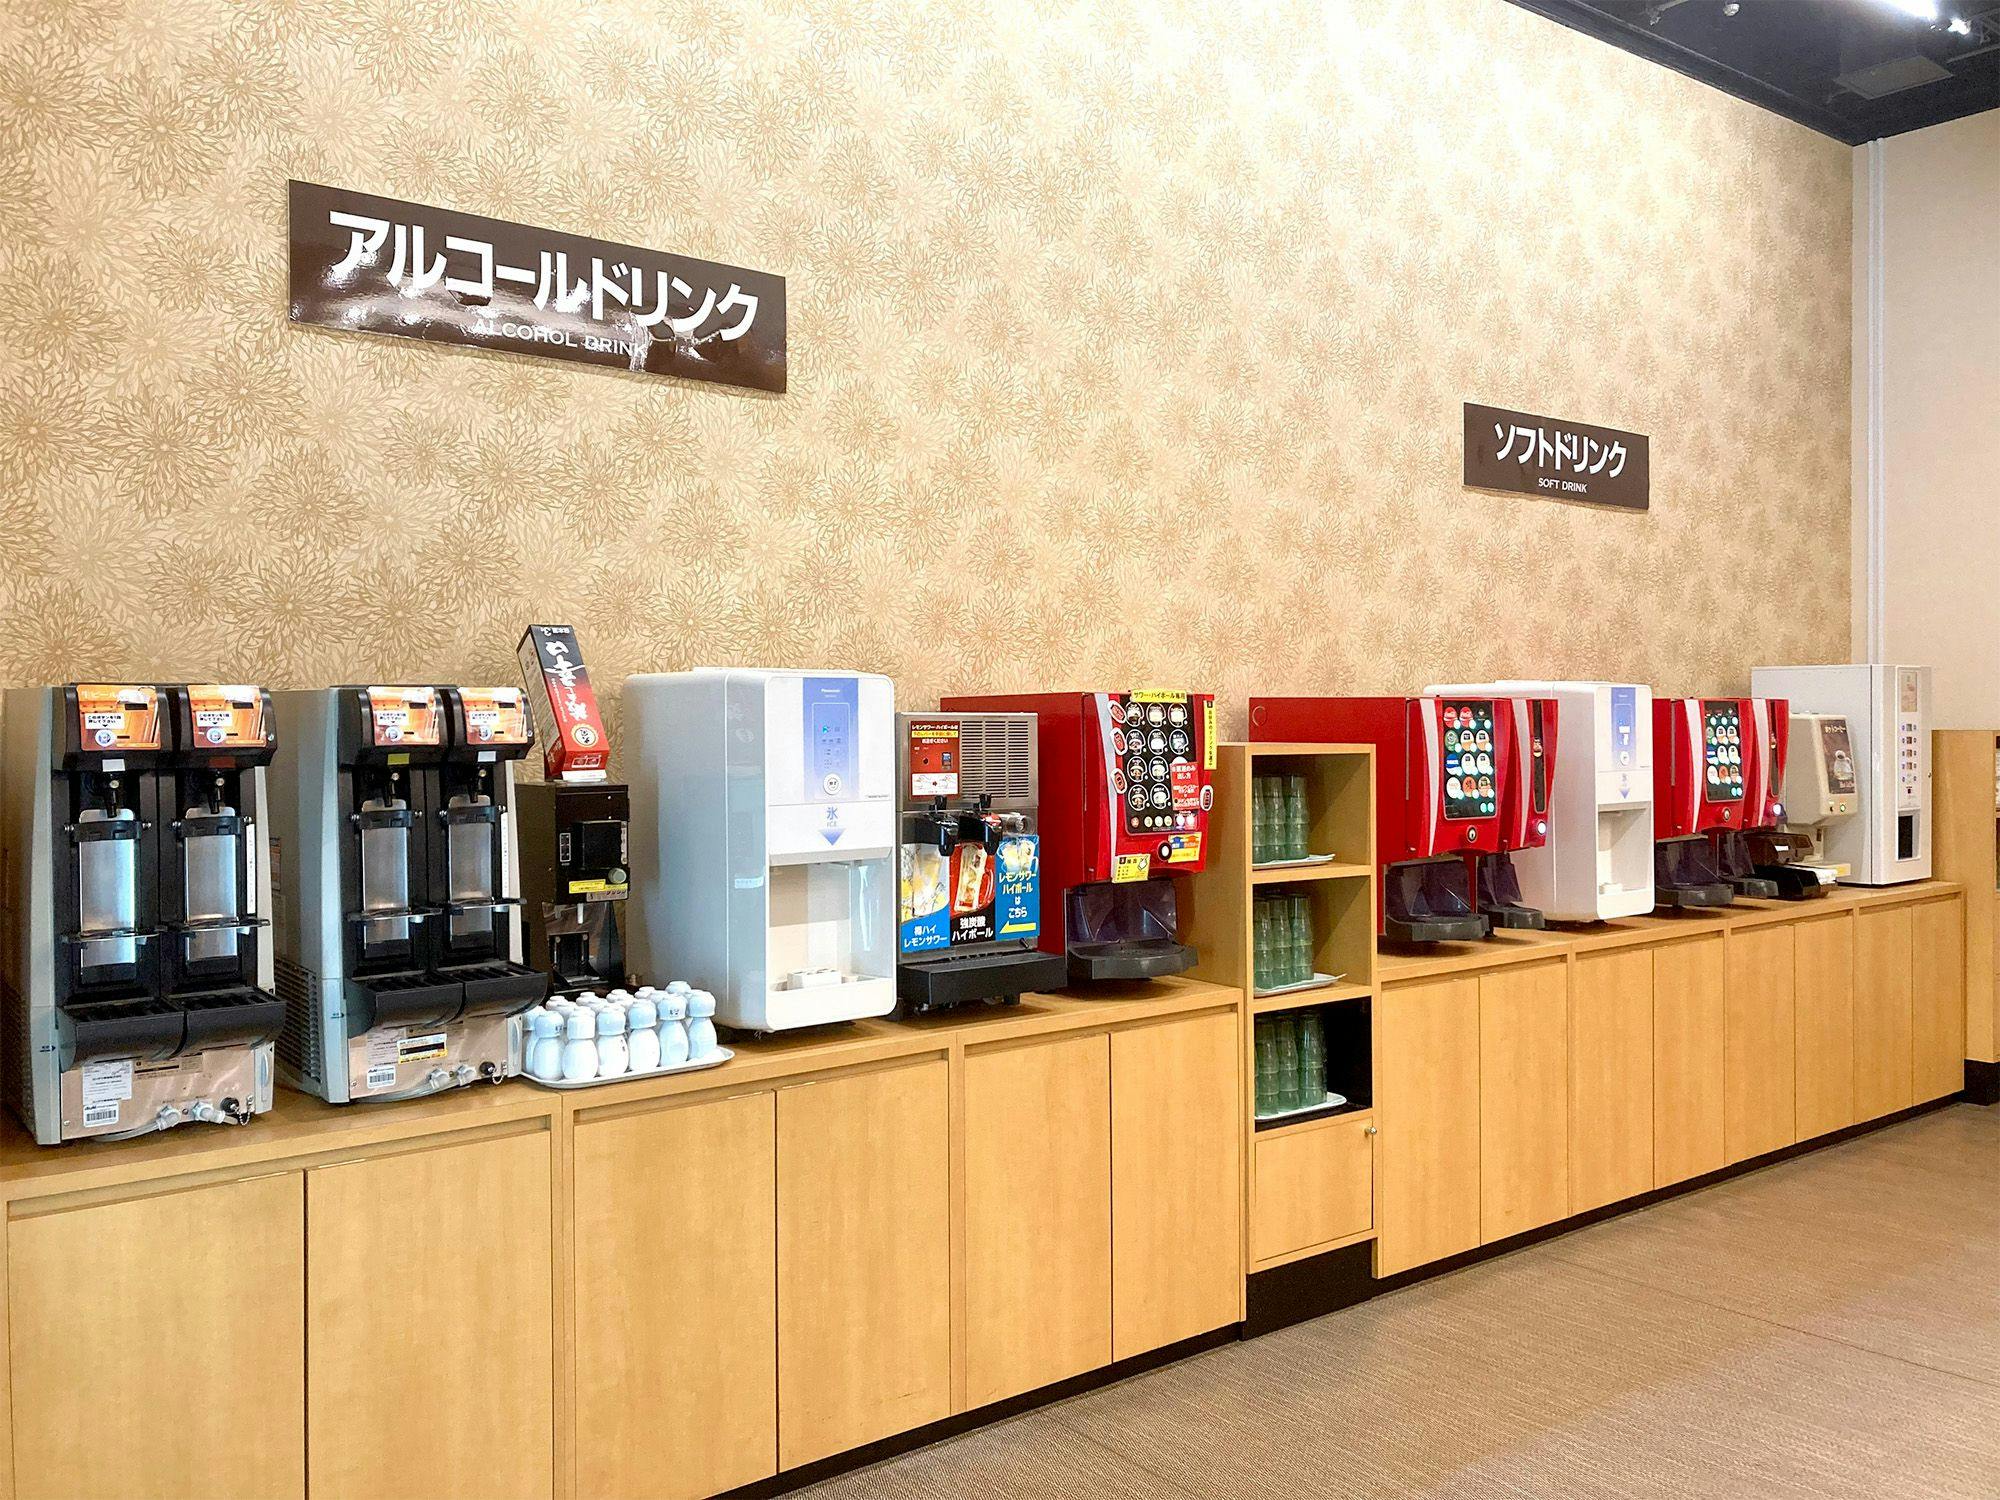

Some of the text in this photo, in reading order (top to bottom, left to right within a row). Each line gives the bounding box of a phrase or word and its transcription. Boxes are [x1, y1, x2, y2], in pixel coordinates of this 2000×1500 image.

[328, 210, 759, 342] アルコールドリンク
[473, 318, 648, 360] ALCOHOL DRINK
[1494, 422, 1627, 478] ソフトドリンク
[1538, 477, 1587, 493] SOFT DRINK
[826, 806, 839, 820] 氷
[998, 871, 1037, 883] レモンサワー
[1002, 883, 1034, 895] ハイボール
[1014, 896, 1022, 905] は
[1008, 907, 1028, 919] こちら
[951, 927, 994, 942] ハイボール
[904, 936, 948, 948] レモンサワー
